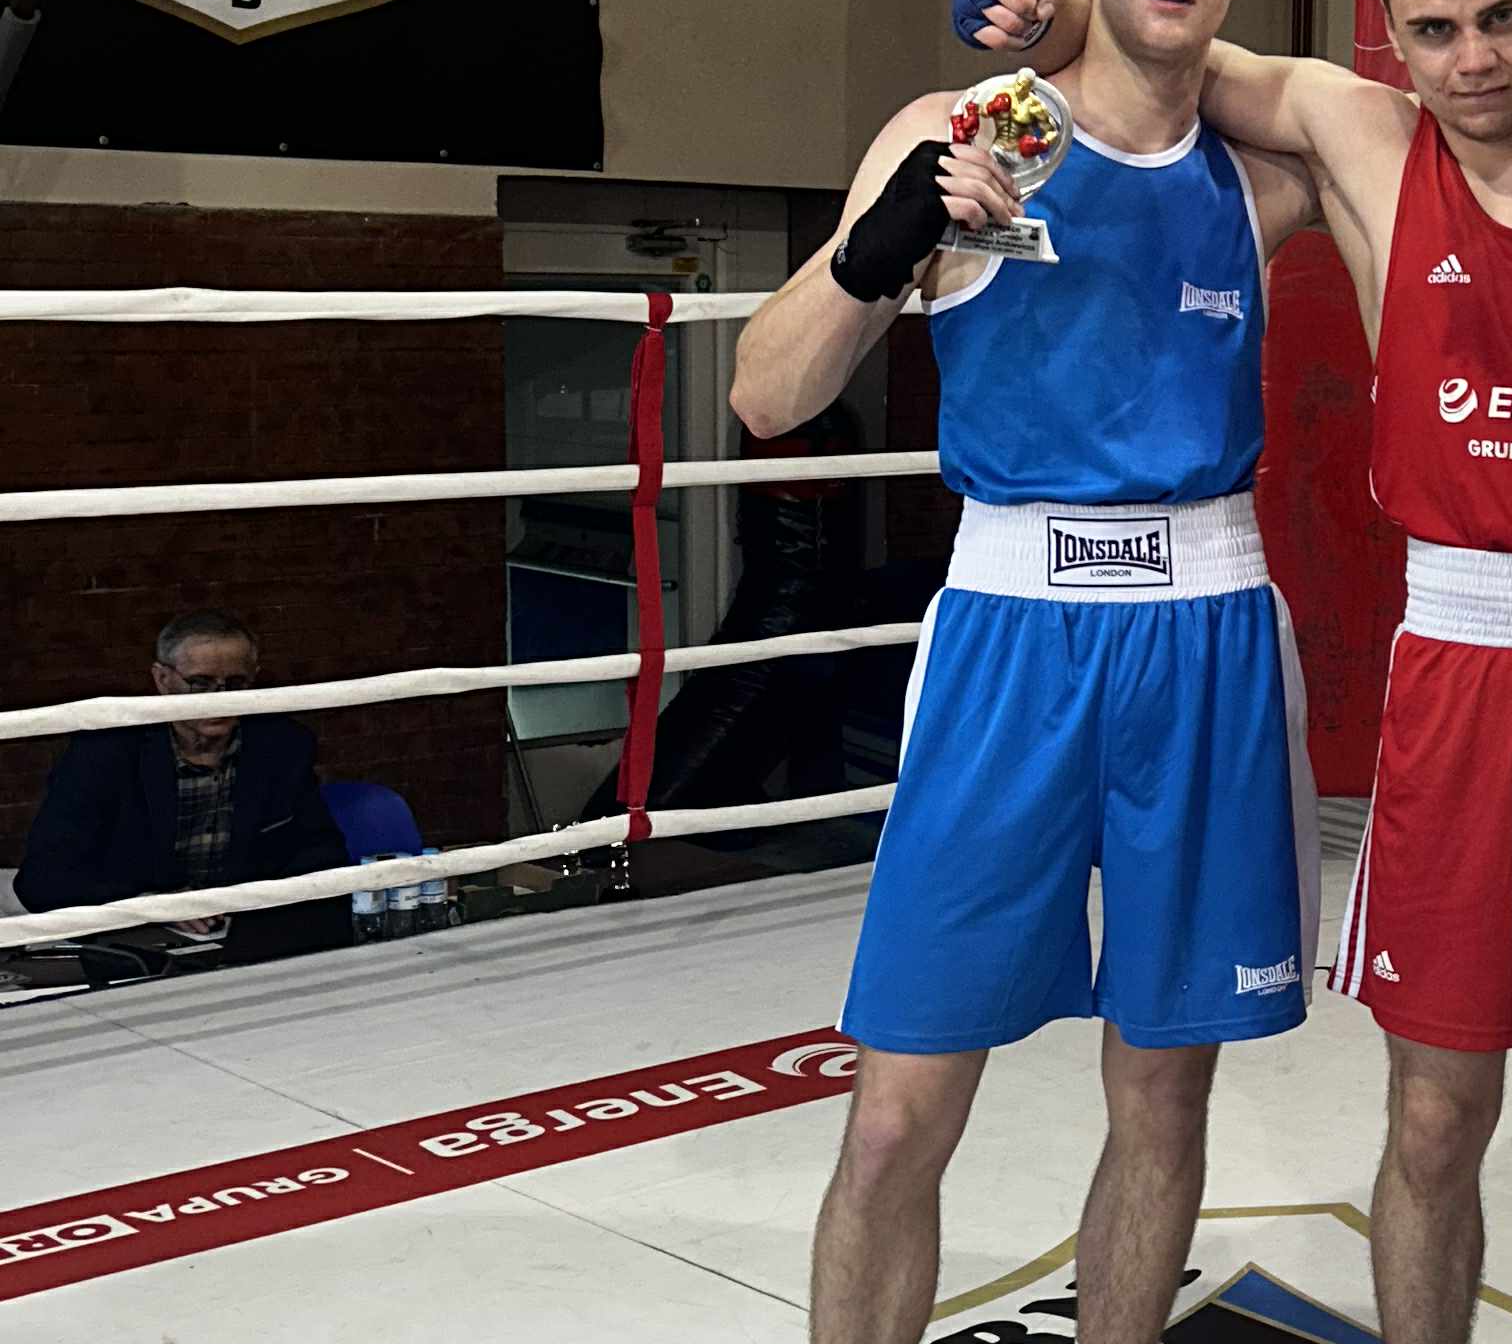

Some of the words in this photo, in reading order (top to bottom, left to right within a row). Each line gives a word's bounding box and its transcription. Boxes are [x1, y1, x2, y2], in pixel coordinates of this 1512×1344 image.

[1427, 271, 1471, 284] adidas
[1179, 280, 1244, 320] LONSDALE
[1053, 528, 1167, 574] LONSDALE
[1090, 569, 1132, 577] LONDON
[1236, 955, 1299, 994] LONSDALE
[419, 1071, 767, 1159] Energa
[124, 1167, 350, 1223] GRUPA
[0, 1223, 112, 1257] OR
